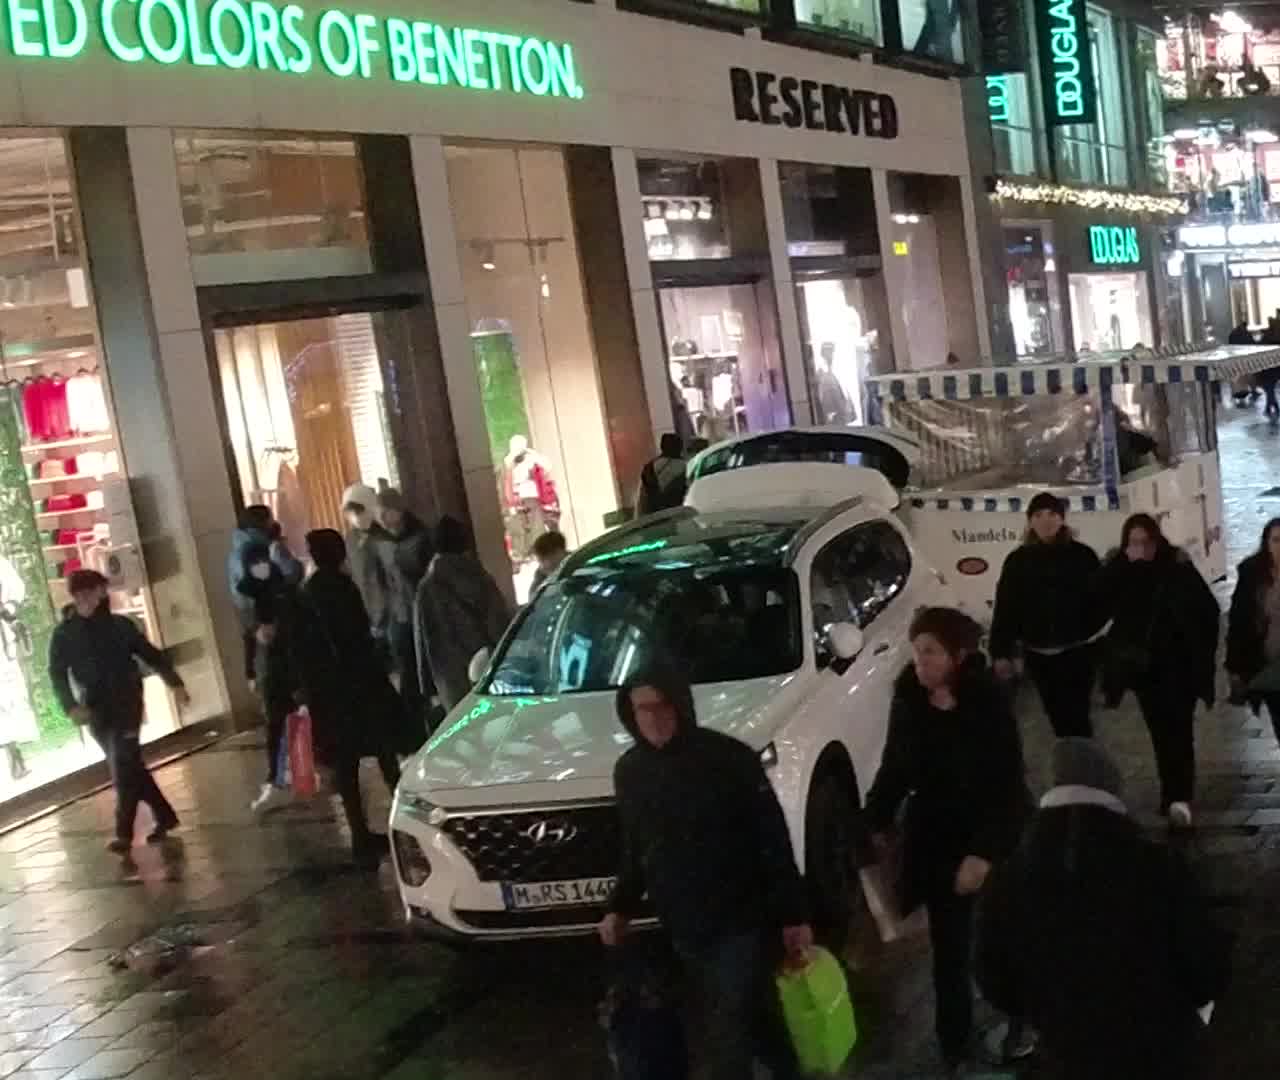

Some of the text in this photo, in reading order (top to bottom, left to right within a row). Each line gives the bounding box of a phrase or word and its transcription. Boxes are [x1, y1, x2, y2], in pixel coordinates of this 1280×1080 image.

[101, 0, 312, 73] COLORS
[319, 9, 380, 78] OF
[729, 67, 898, 139] RESERVED
[1090, 225, 1140, 264] DOUGLAS
